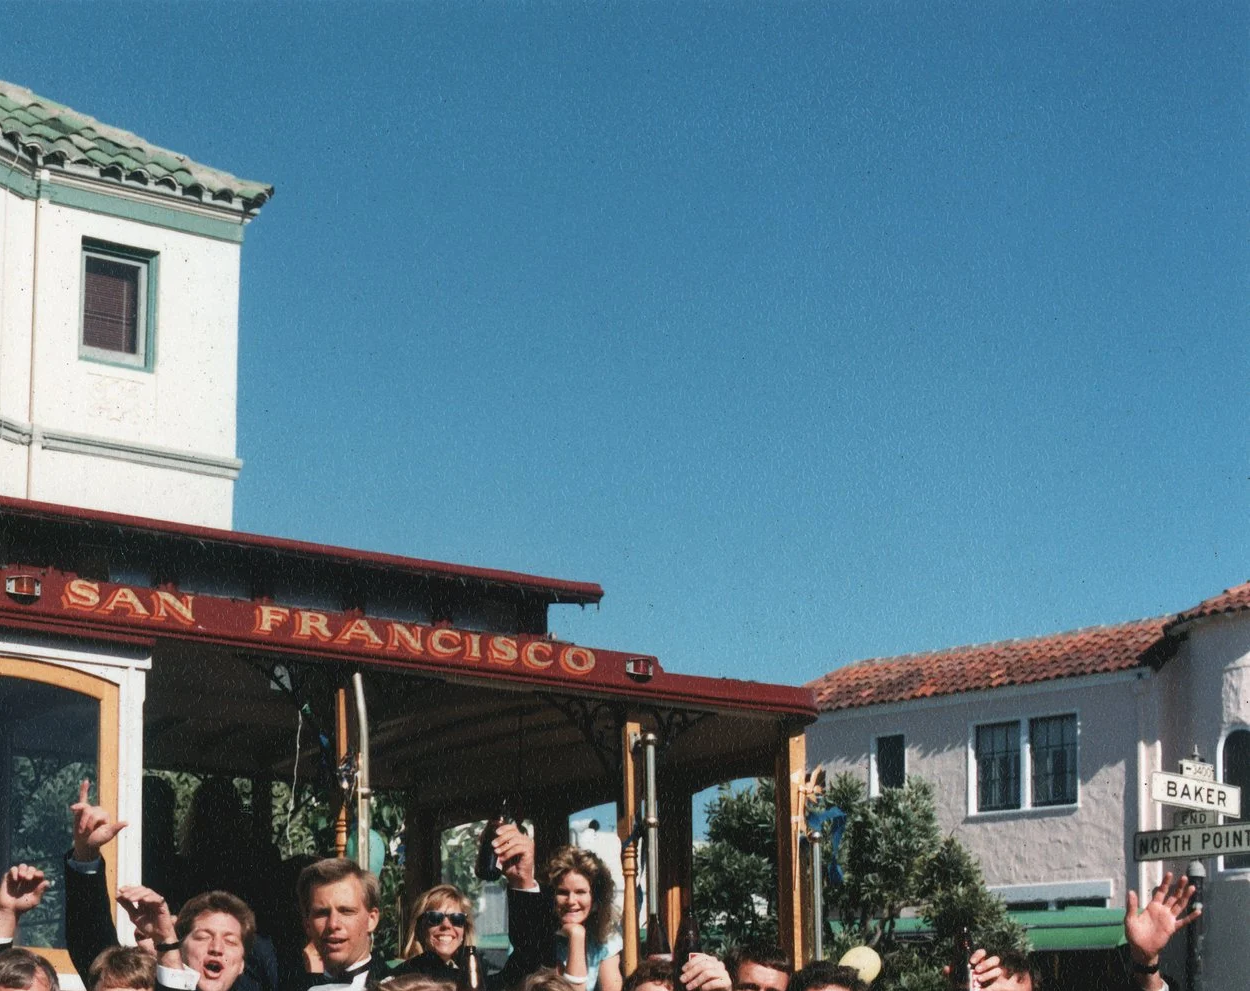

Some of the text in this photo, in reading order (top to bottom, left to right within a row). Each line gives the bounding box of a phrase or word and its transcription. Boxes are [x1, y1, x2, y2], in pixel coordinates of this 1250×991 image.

[62, 579, 196, 625] SAN
[253, 604, 597, 677] FRANCISCO
[1166, 780, 1227, 808] BAKER
[1181, 812, 1207, 825] END
[1138, 829, 1250, 856] NORTH POINT
